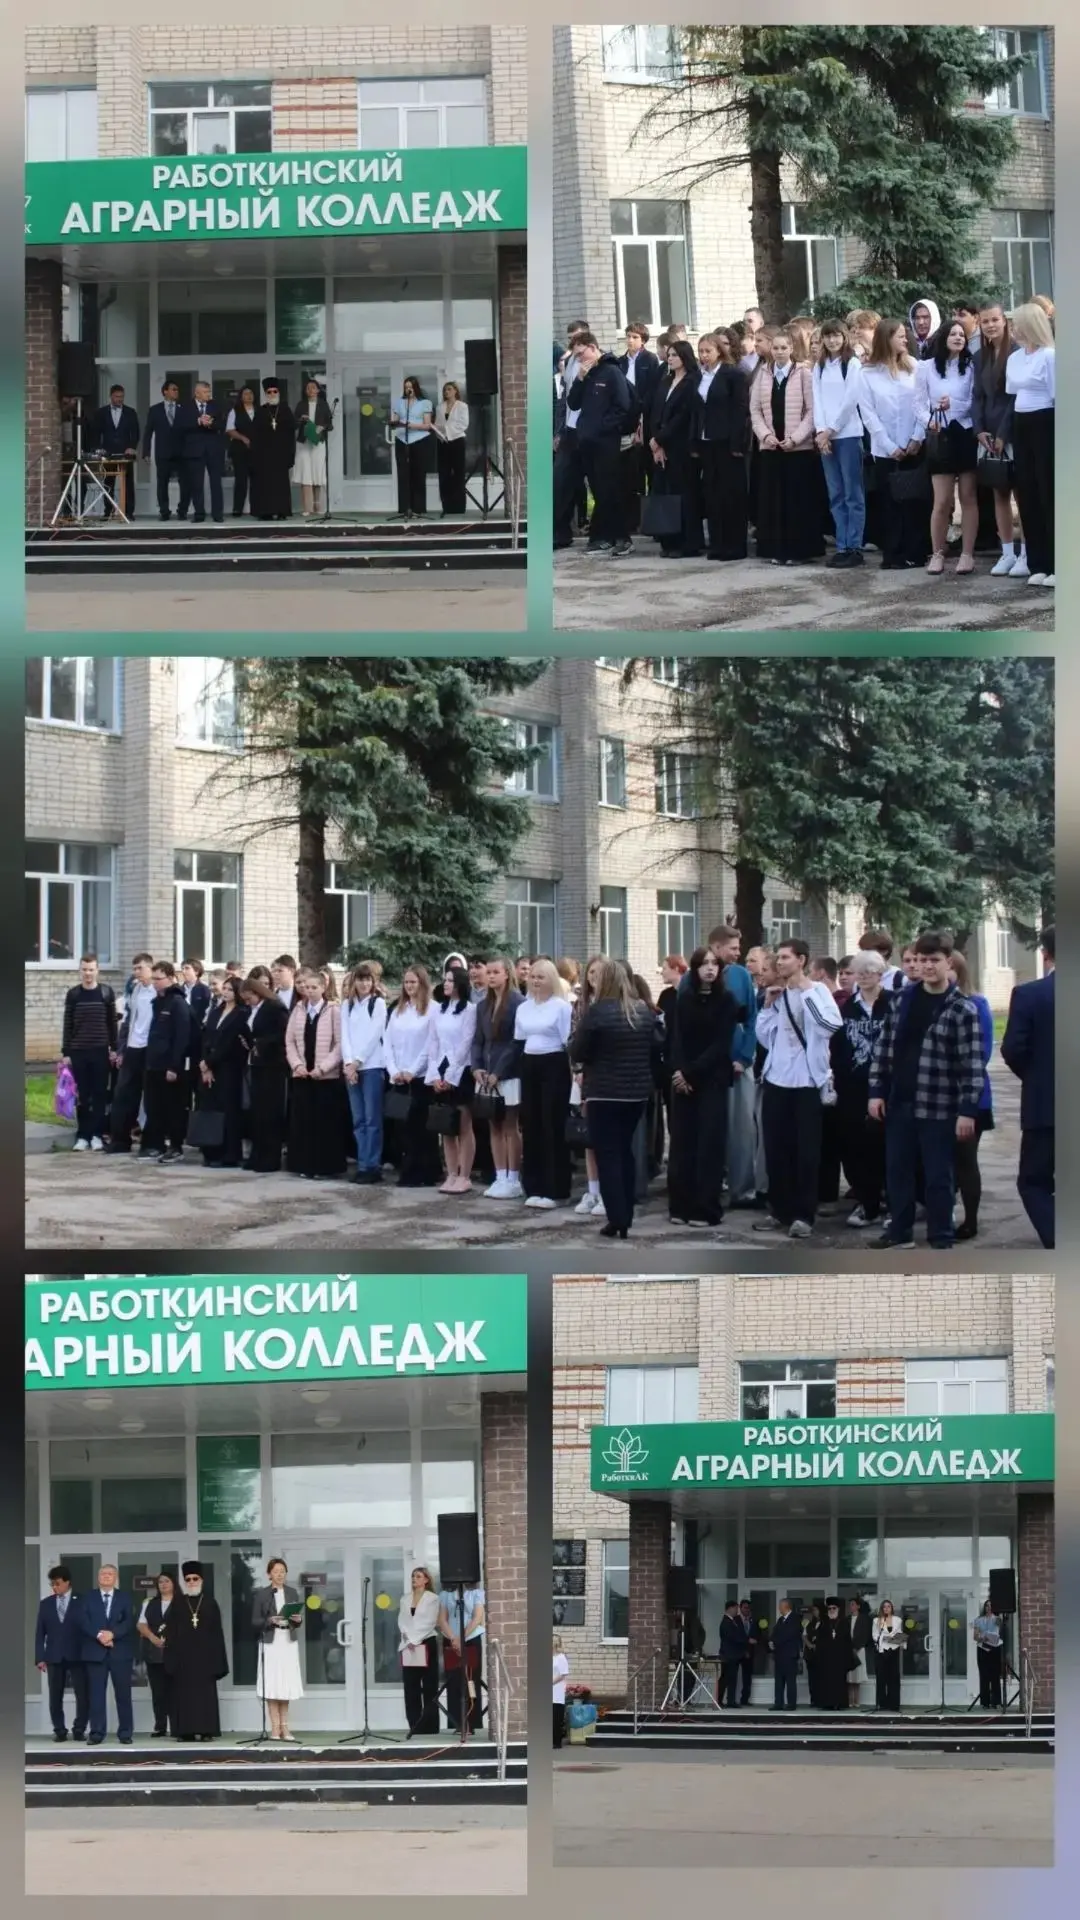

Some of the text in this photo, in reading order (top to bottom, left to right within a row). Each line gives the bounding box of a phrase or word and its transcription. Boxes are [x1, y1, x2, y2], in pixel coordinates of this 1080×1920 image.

[152, 153, 403, 189] РАБОТКИНСКИЙ
[60, 189, 502, 234] АГРАРНЫЙ КОЛЛЕДЖ
[40, 1274, 359, 1323] РАБОТКИНСКИЙ
[25, 1320, 487, 1378] АРНЫЙ КОЛЛЕДЖ
[744, 1418, 943, 1446] РАБОТКИНСКИЙ
[671, 1447, 1023, 1481] АГРАРНЫЙ КОЛЛЕДЖ
